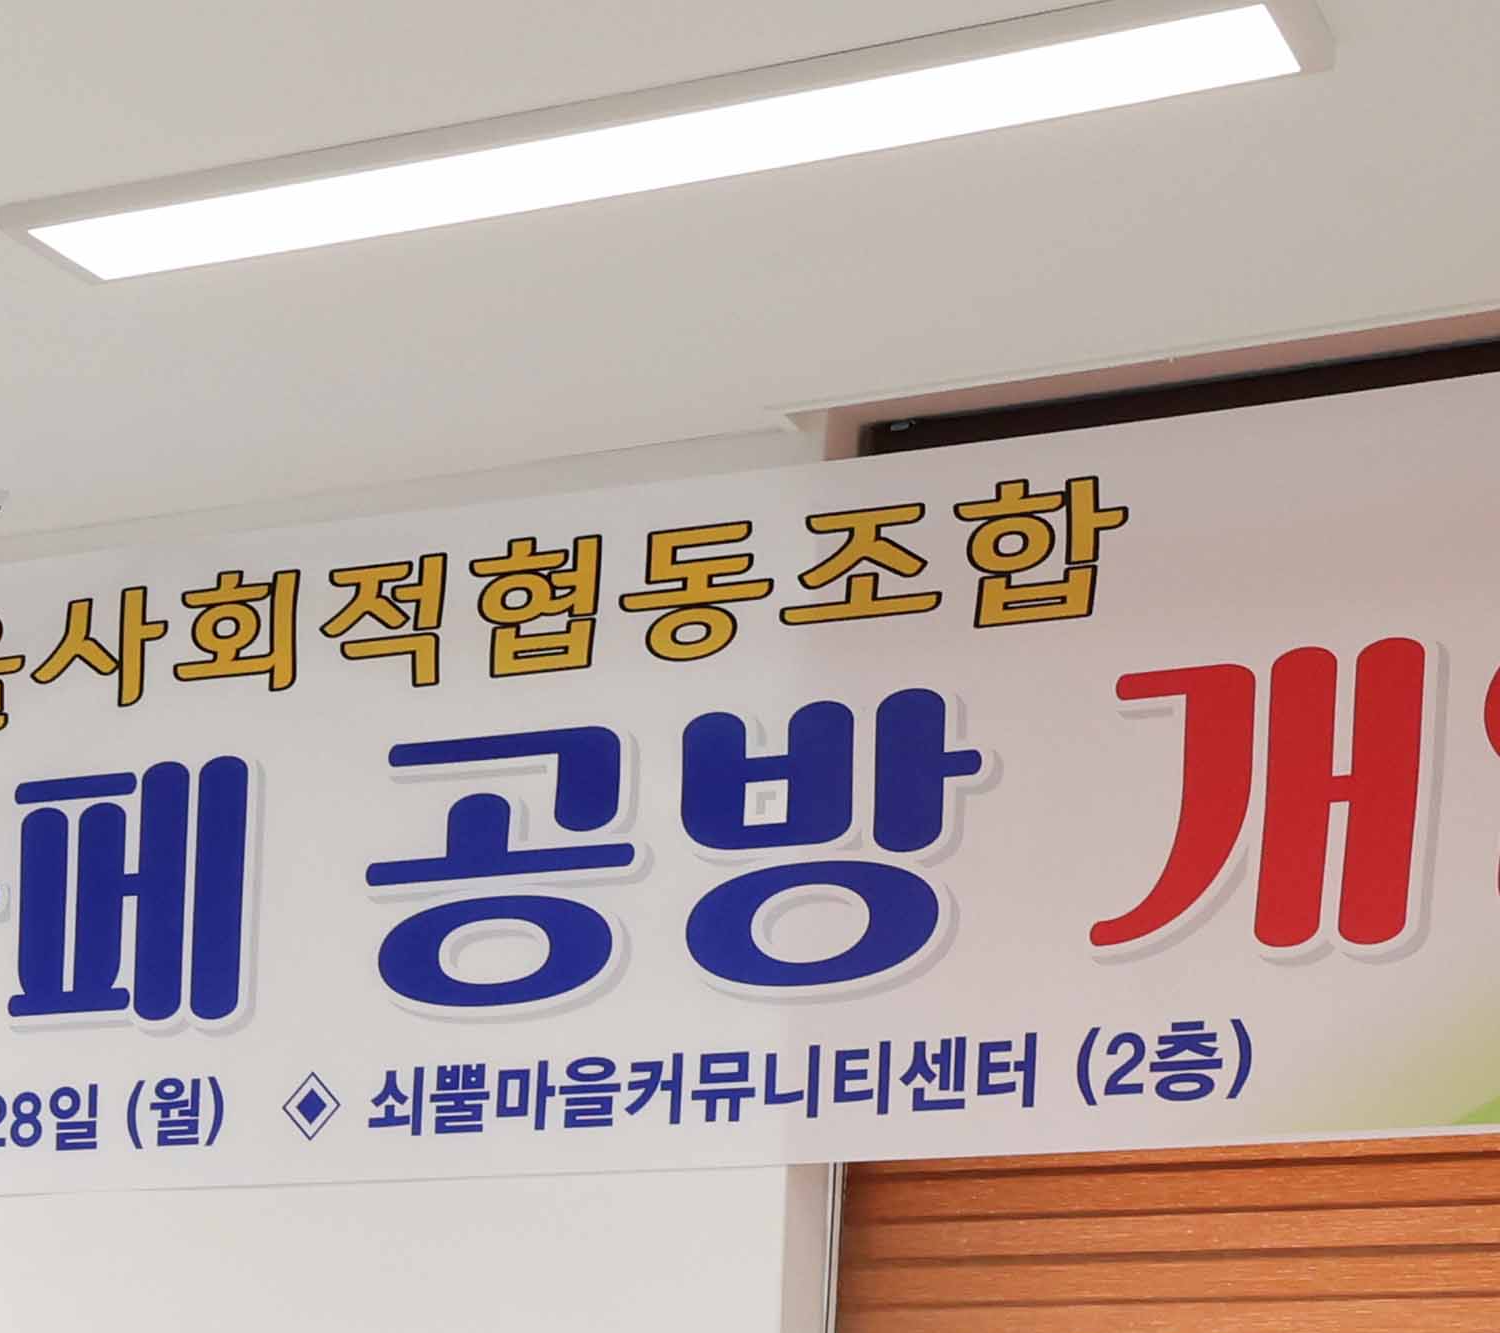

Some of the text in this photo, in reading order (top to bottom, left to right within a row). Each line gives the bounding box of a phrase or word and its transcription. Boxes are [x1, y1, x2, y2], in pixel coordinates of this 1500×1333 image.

[367, 688, 982, 1007] 공방
[1089, 637, 1500, 947] 개
[127, 1076, 225, 1149] (월)
[368, 1032, 1038, 1137] 쇠뿔마을커뮤니티센터
[1077, 1018, 1252, 1106] (2층)
